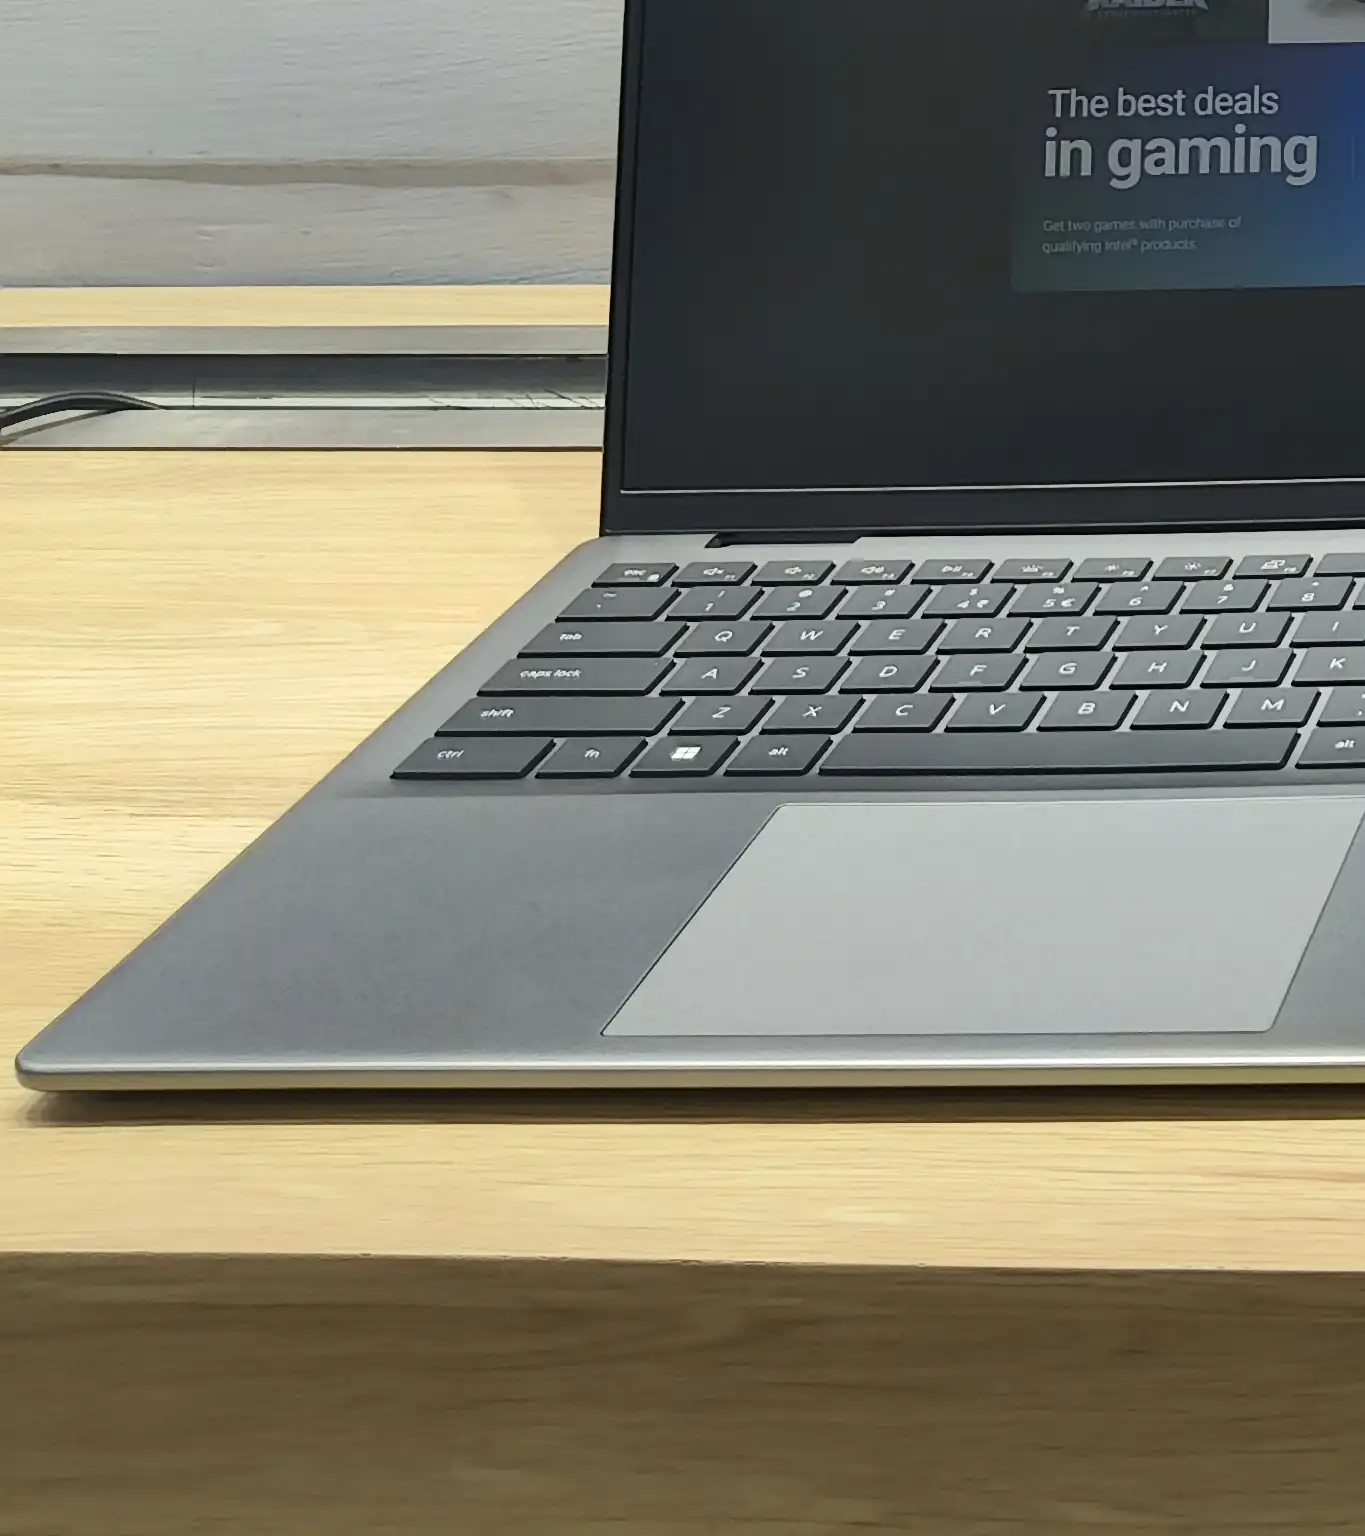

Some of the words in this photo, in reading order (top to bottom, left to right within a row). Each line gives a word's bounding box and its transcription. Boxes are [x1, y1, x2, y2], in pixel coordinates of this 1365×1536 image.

[1048, 88, 1109, 118] The
[1117, 86, 1186, 117] best
[1194, 84, 1280, 115] deals
[1045, 126, 1092, 177] in
[1108, 123, 1318, 190] gaming
[1043, 220, 1065, 232] Get
[1068, 220, 1091, 231] two
[1094, 220, 1136, 233] games
[1139, 217, 1165, 230] with
[1228, 215, 1242, 228] of
[560, 632, 582, 641] tab
[714, 631, 733, 643] Q
[800, 630, 823, 641] W
[888, 629, 905, 640] E
[975, 627, 992, 638] R
[1066, 626, 1080, 637] T
[520, 669, 551, 680] caps
[554, 669, 582, 678] lock
[481, 708, 514, 718] shift
[437, 749, 465, 760] ctrl
[585, 749, 600, 758] fn
[768, 747, 789, 757] alt
[1334, 739, 1356, 750] alt
